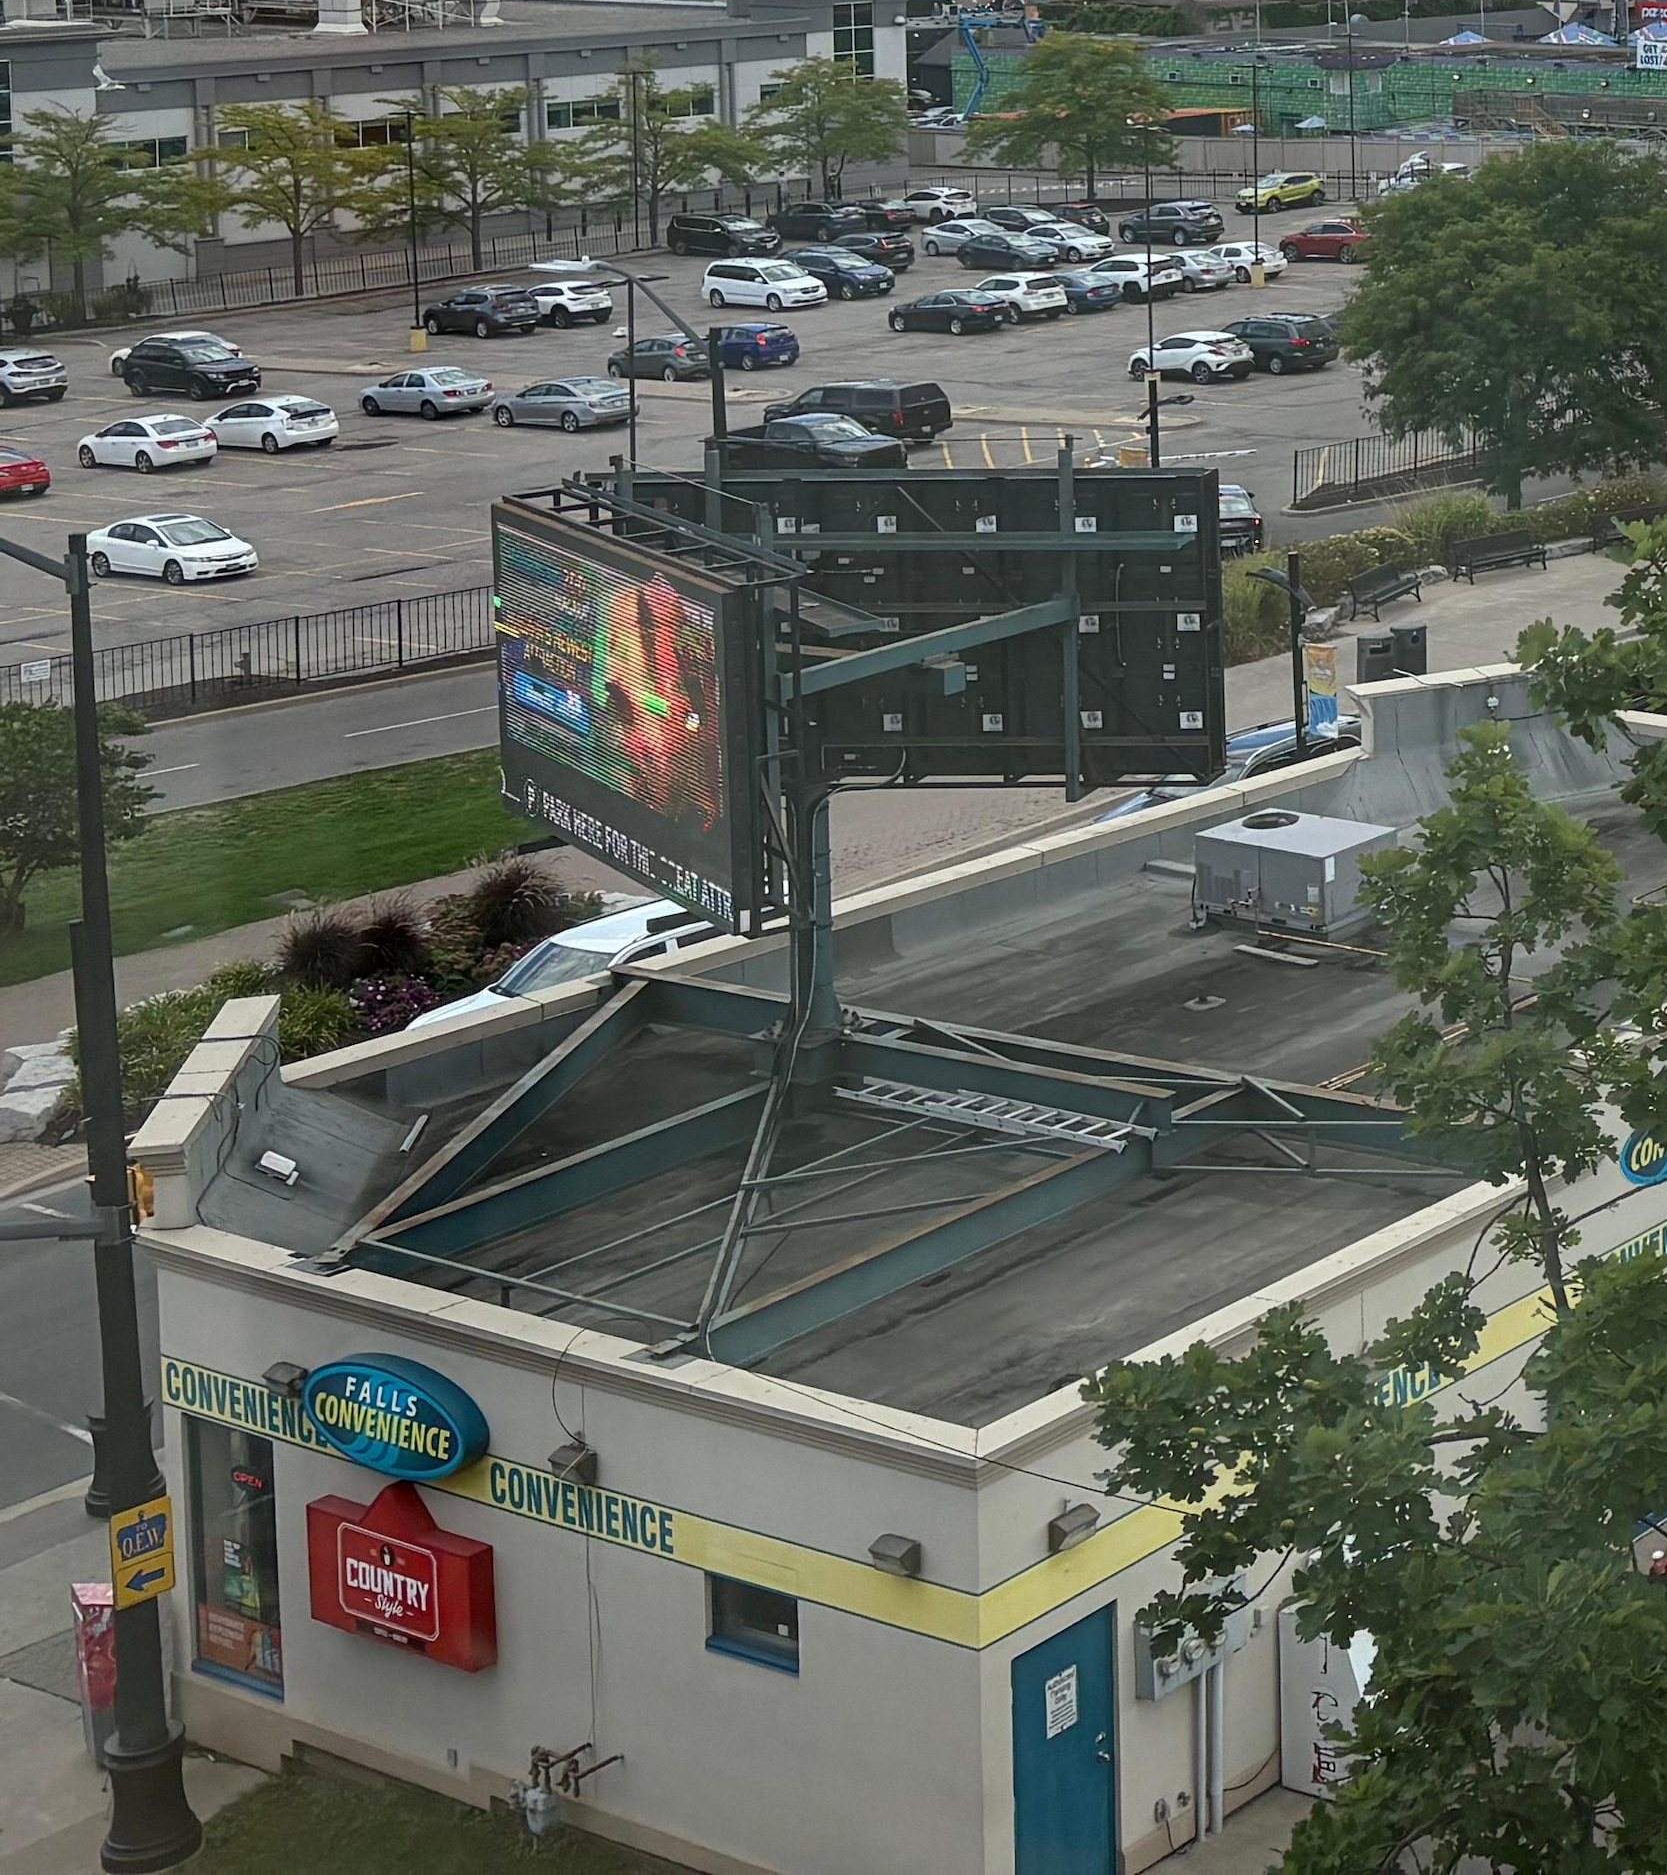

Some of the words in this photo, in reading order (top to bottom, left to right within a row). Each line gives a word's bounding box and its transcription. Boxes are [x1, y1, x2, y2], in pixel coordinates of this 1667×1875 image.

[1642, 43, 1658, 54] GET
[604, 825, 630, 865] FOR
[345, 1376, 418, 1418] FALLS
[314, 1391, 451, 1461] CONVENIENCE
[232, 1471, 264, 1489] OPEN
[490, 1461, 674, 1555] CONVENIENCE
[345, 1556, 430, 1611] COUNTRY
[374, 1593, 404, 1619] Style
